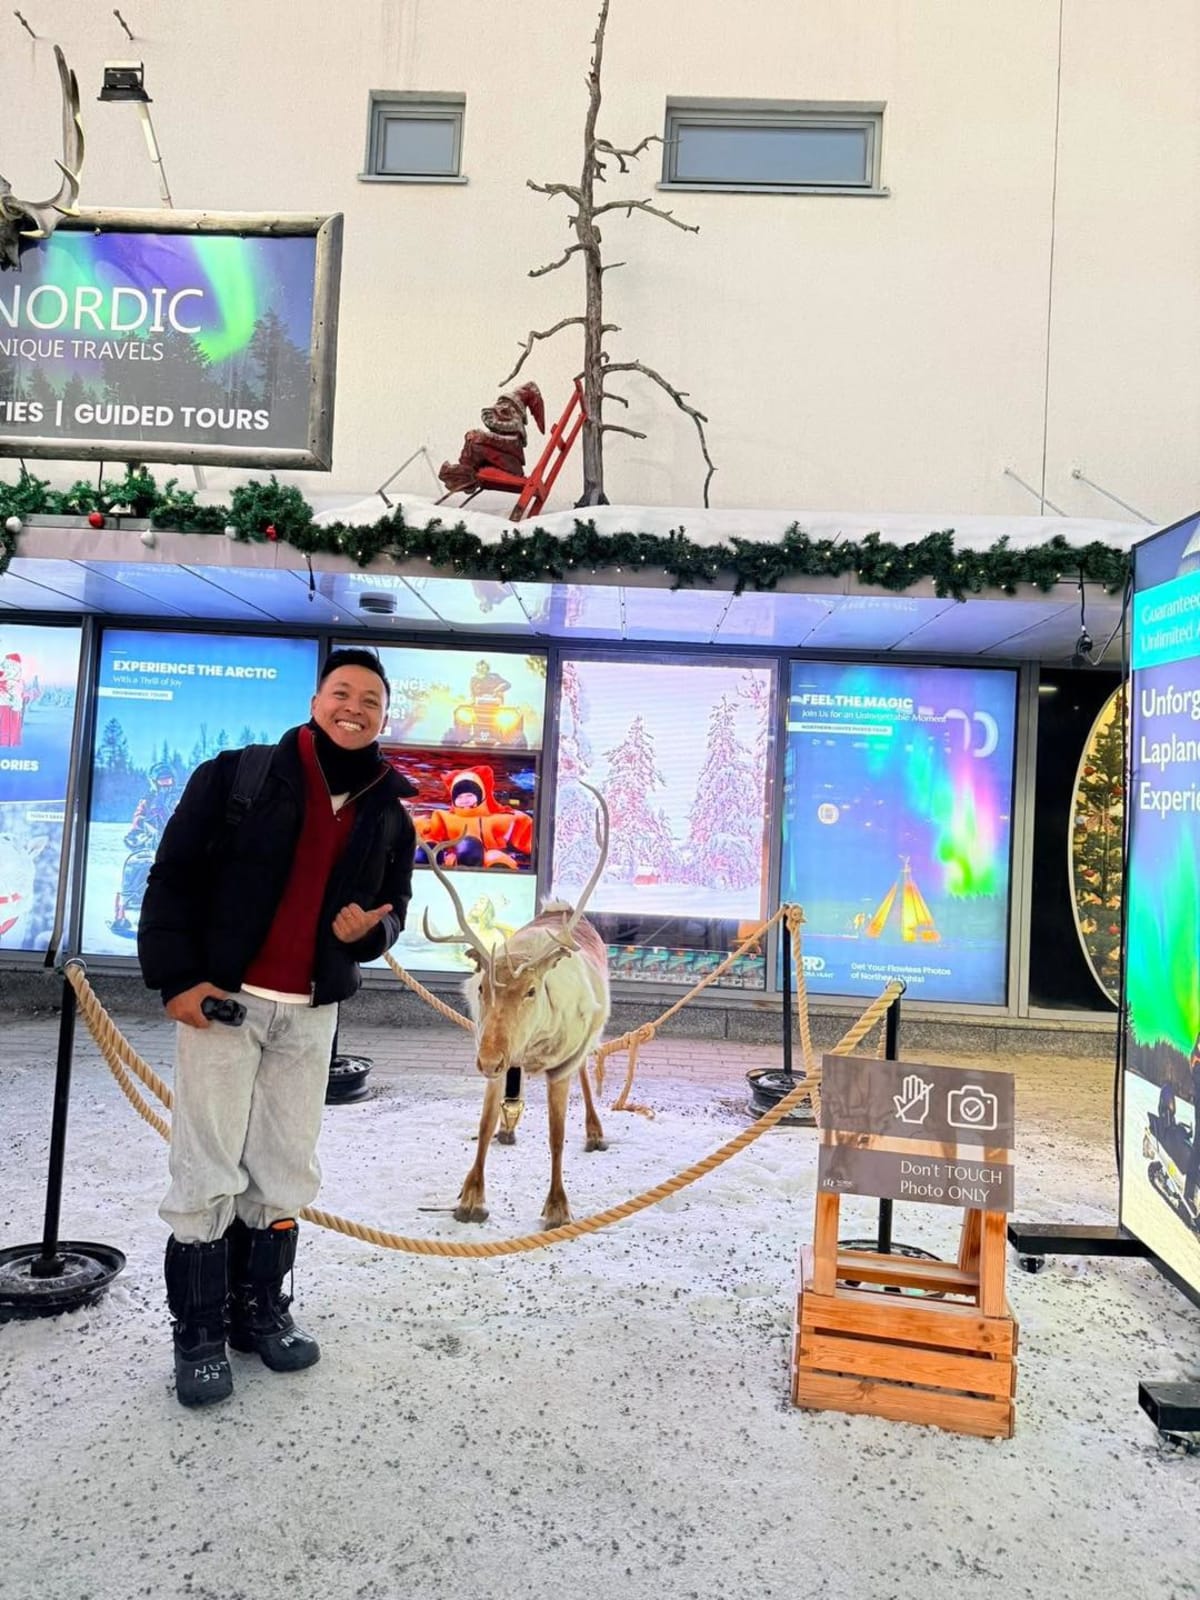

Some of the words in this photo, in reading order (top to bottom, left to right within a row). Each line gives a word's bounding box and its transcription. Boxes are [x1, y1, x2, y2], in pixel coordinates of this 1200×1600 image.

[0, 284, 205, 335] NORDIC
[71, 339, 164, 361] TRAVELS
[75, 403, 174, 427] GUIDED
[180, 406, 270, 430] TOURS
[1142, 618, 1194, 652] Unlimited
[113, 660, 195, 675] EXPERIENCE
[197, 665, 223, 677] THE
[224, 666, 278, 680] ARCTIC
[802, 693, 834, 706] FEEL
[835, 694, 863, 707] THE
[864, 696, 913, 709] MAGIC
[802, 709, 818, 719] Join
[819, 711, 829, 719] Us
[830, 710, 841, 719] for
[850, 971, 859, 979] of
[851, 961, 866, 971] Get
[868, 963, 886, 972] Your
[923, 966, 952, 976] Photos
[900, 1160, 940, 1178] Don't
[944, 1165, 1002, 1185] TOUCH
[900, 1179, 943, 1198] Photo
[948, 1185, 990, 1203] ONLY
